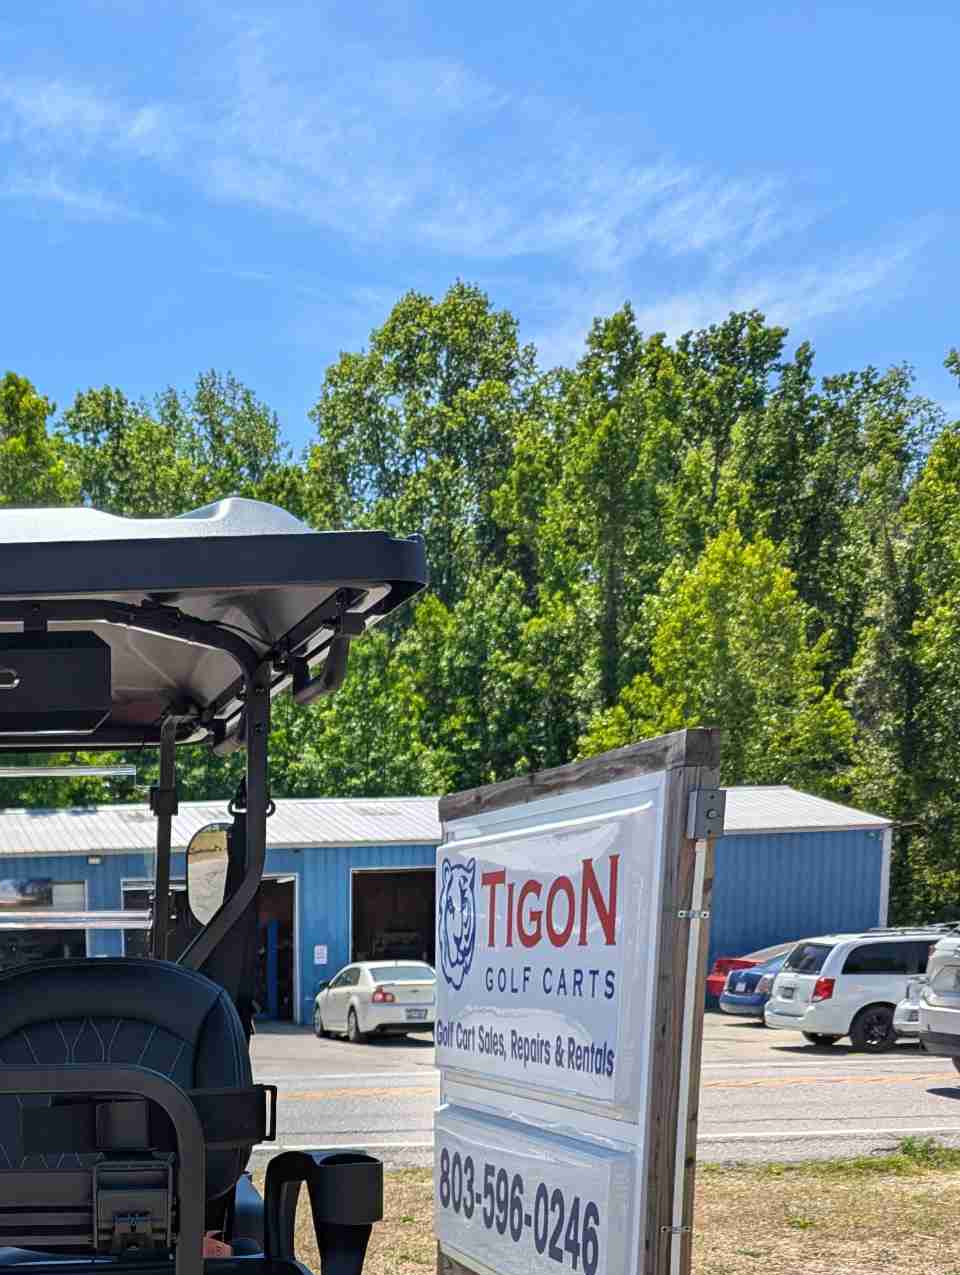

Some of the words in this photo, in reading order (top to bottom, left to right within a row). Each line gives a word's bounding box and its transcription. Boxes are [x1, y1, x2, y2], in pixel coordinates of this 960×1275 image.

[480, 853, 620, 948] TIGON
[485, 966, 531, 993] GOLF
[542, 967, 615, 999] CARTS
[436, 1020, 454, 1046] Golf
[456, 1022, 475, 1051] Cart
[478, 1023, 506, 1061] Sales,
[511, 1029, 551, 1067] Repairs
[555, 1035, 564, 1068] &
[567, 1036, 615, 1077] Rentals
